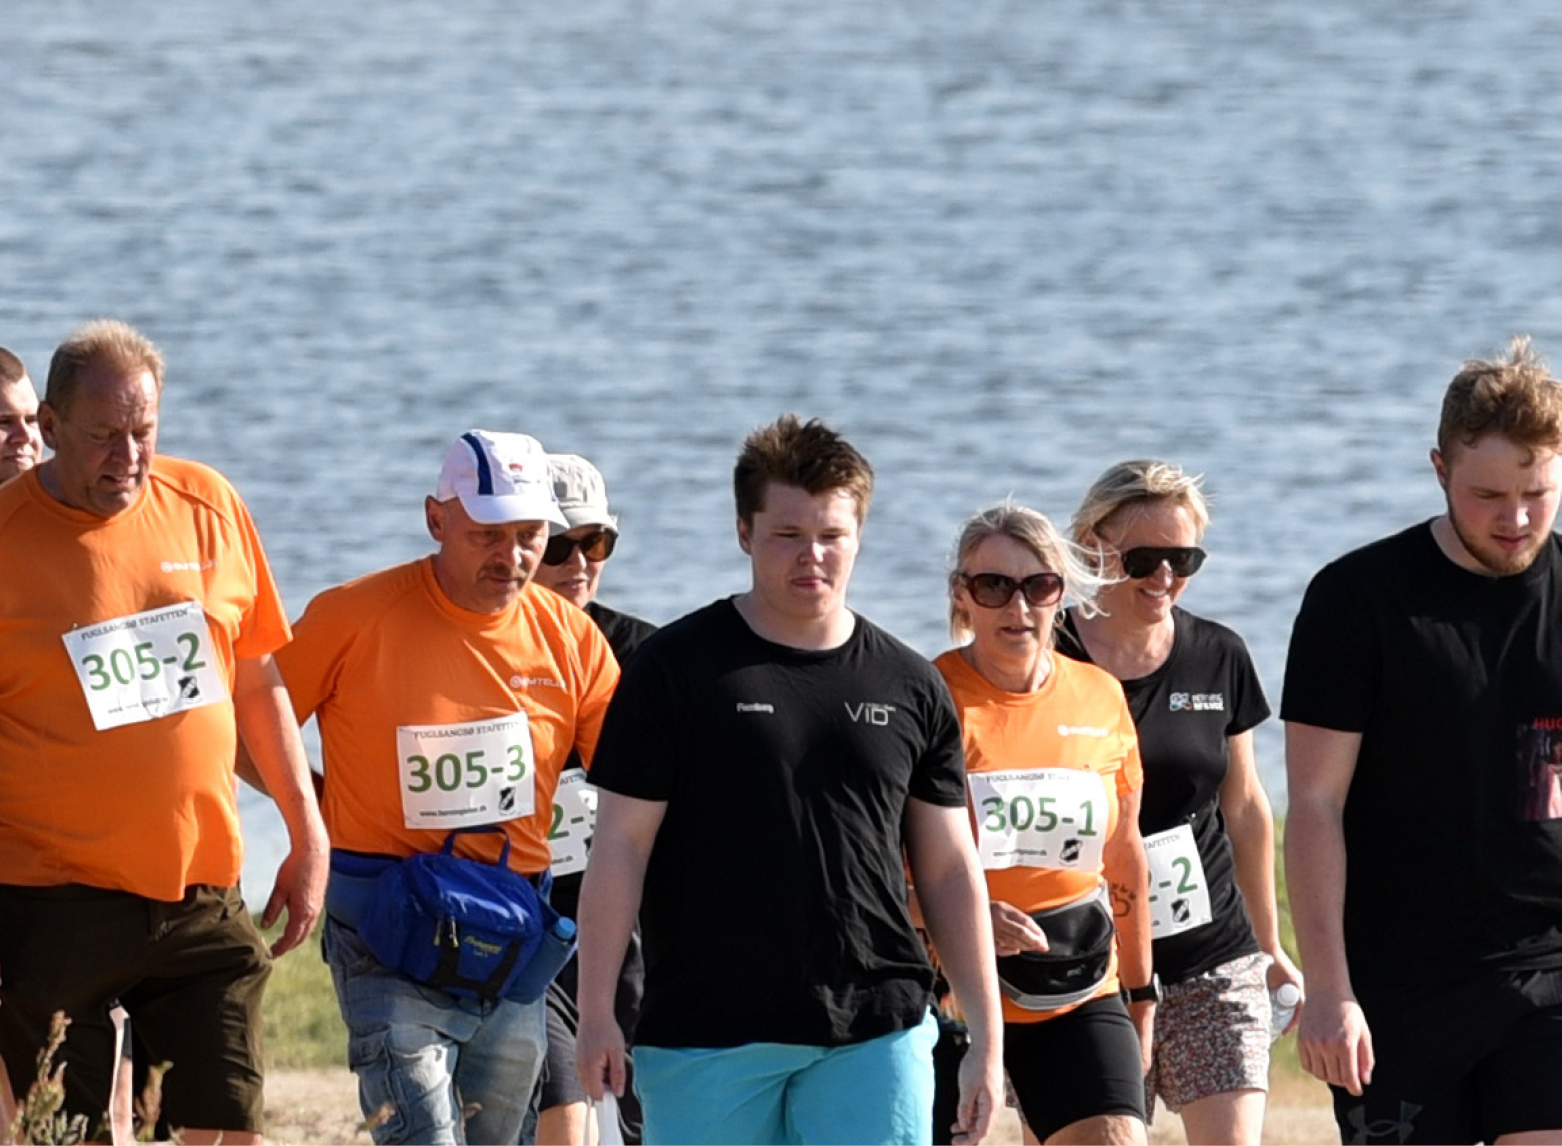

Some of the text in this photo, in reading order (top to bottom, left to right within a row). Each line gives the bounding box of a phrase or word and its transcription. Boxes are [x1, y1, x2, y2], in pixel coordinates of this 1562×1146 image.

[138, 609, 188, 627] STAFETTEN
[81, 632, 207, 691] 305-2
[406, 744, 527, 793] 305-3
[981, 795, 1098, 836] 305-1
